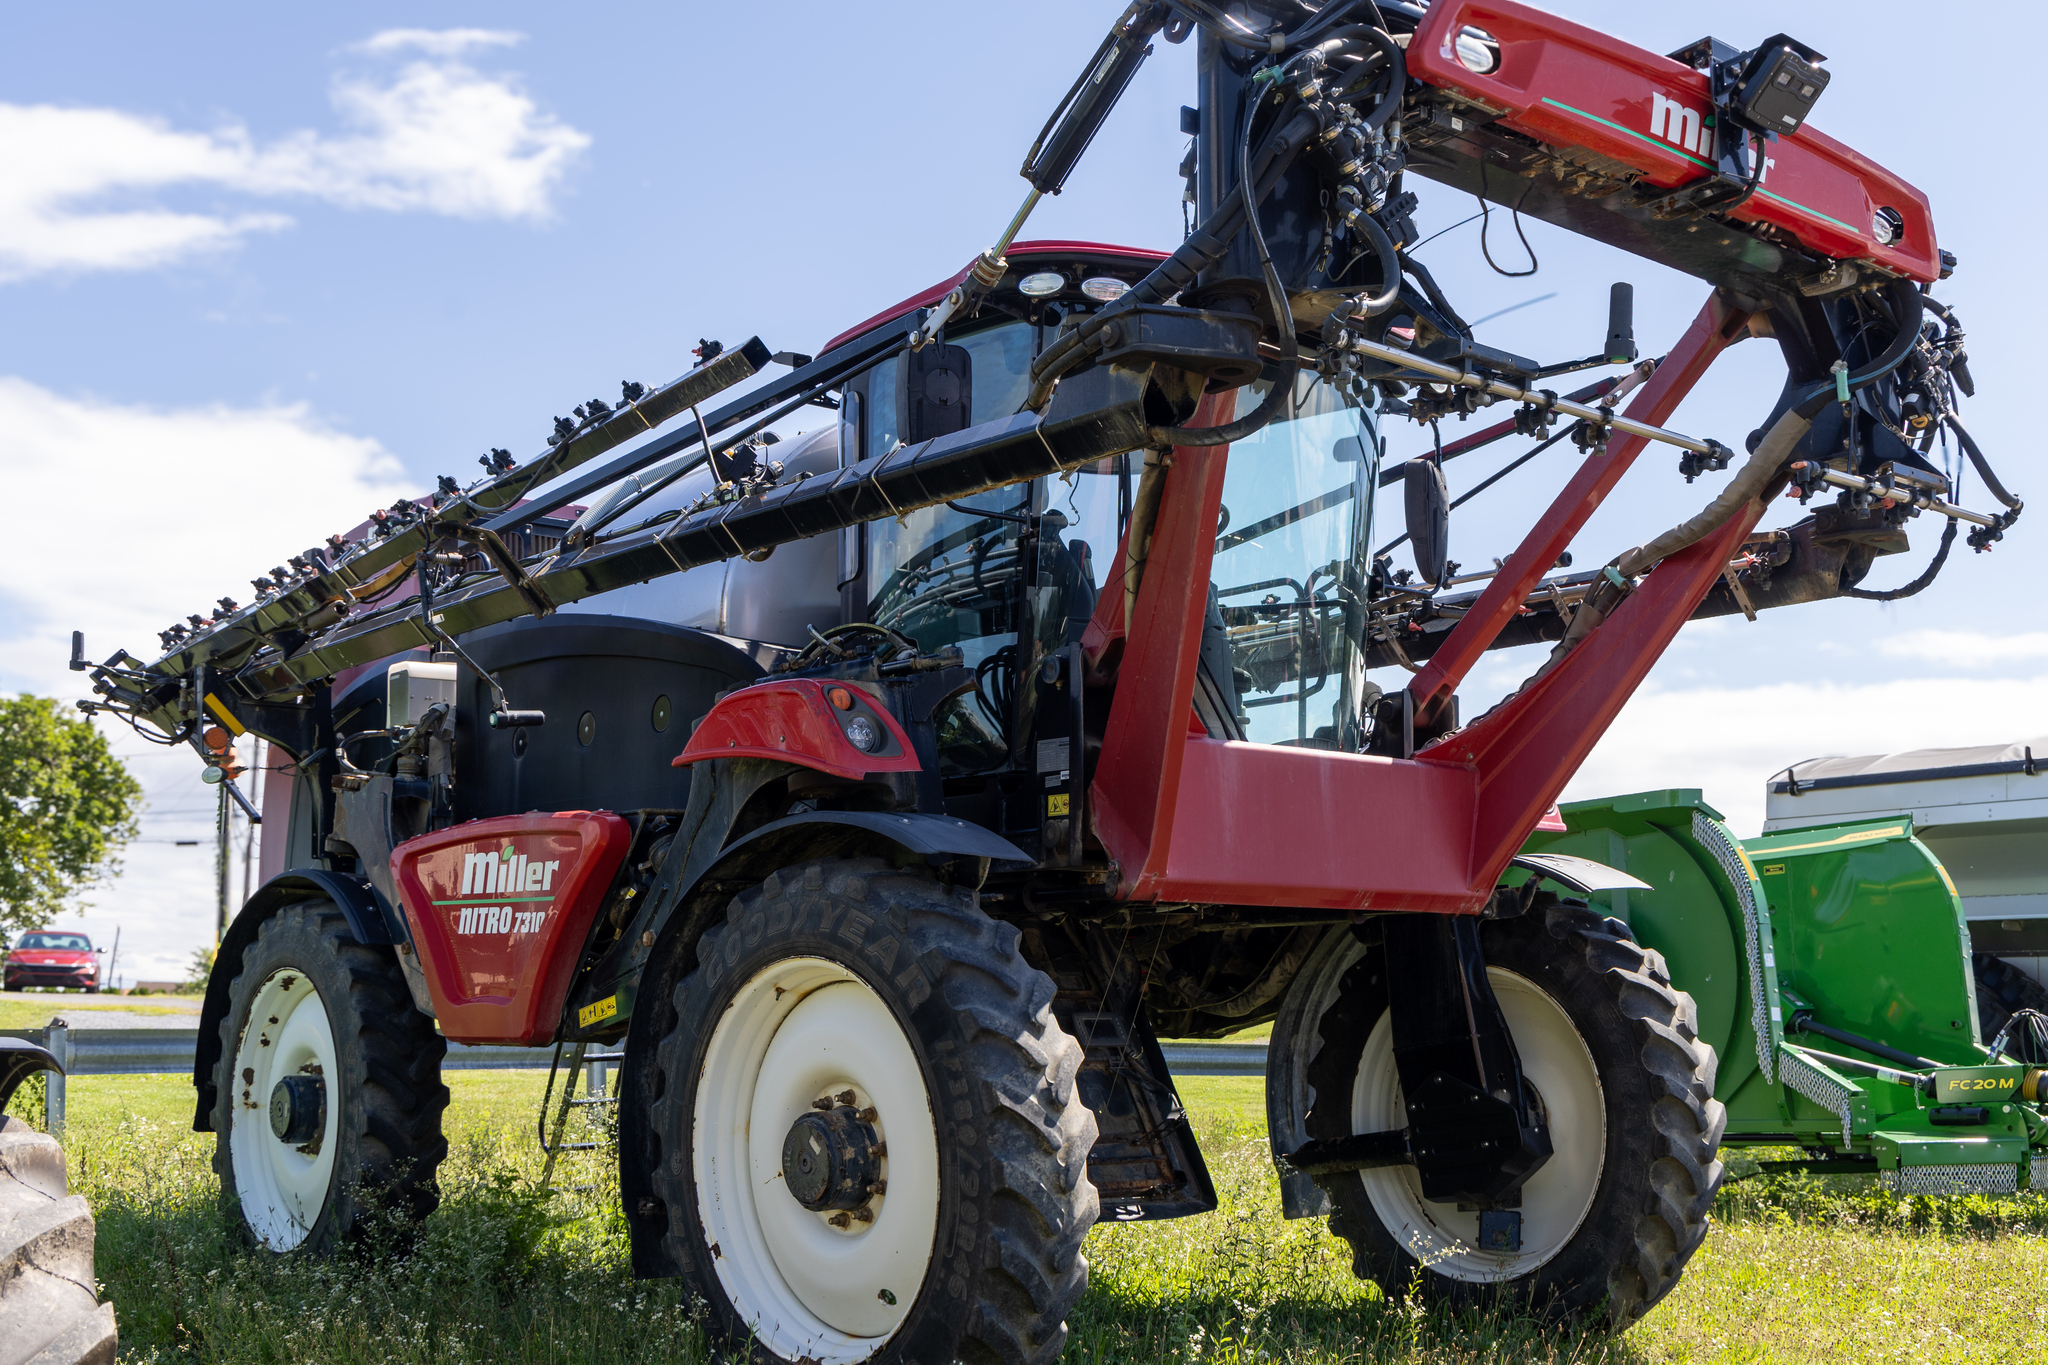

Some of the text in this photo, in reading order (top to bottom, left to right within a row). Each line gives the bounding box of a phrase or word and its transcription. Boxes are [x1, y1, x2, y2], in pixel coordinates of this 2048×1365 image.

[461, 845, 560, 895] Miller
[458, 906, 546, 935] NITRO 7310
[706, 896, 932, 1009] GOODYEAR
[1948, 1077, 2015, 1091] FC 20 M
